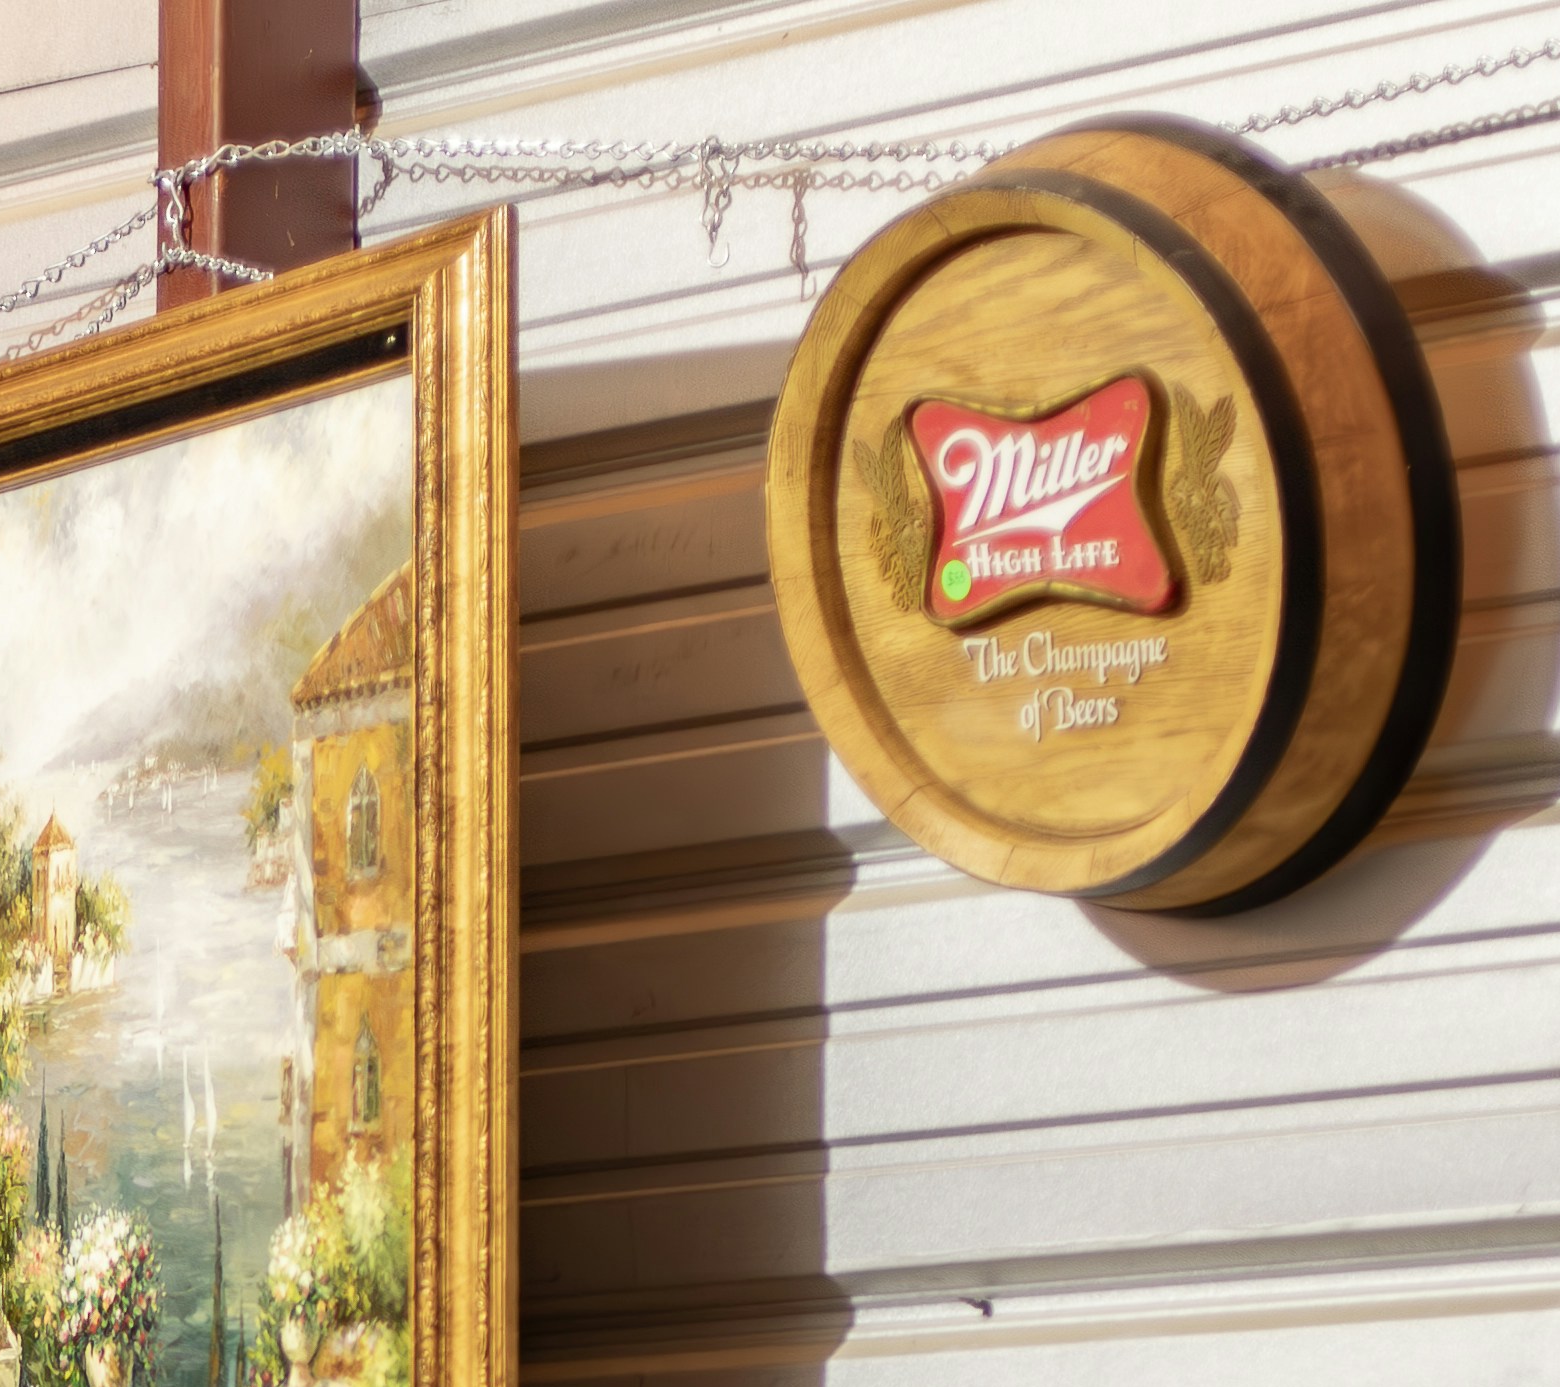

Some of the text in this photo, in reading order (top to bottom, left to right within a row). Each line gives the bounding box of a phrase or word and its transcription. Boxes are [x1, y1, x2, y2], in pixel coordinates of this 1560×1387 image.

[938, 427, 1129, 528] Miller
[967, 535, 1120, 577] HIGH LIFE
[963, 631, 1168, 685] The Champagne
[1019, 687, 1119, 742] of Beers
